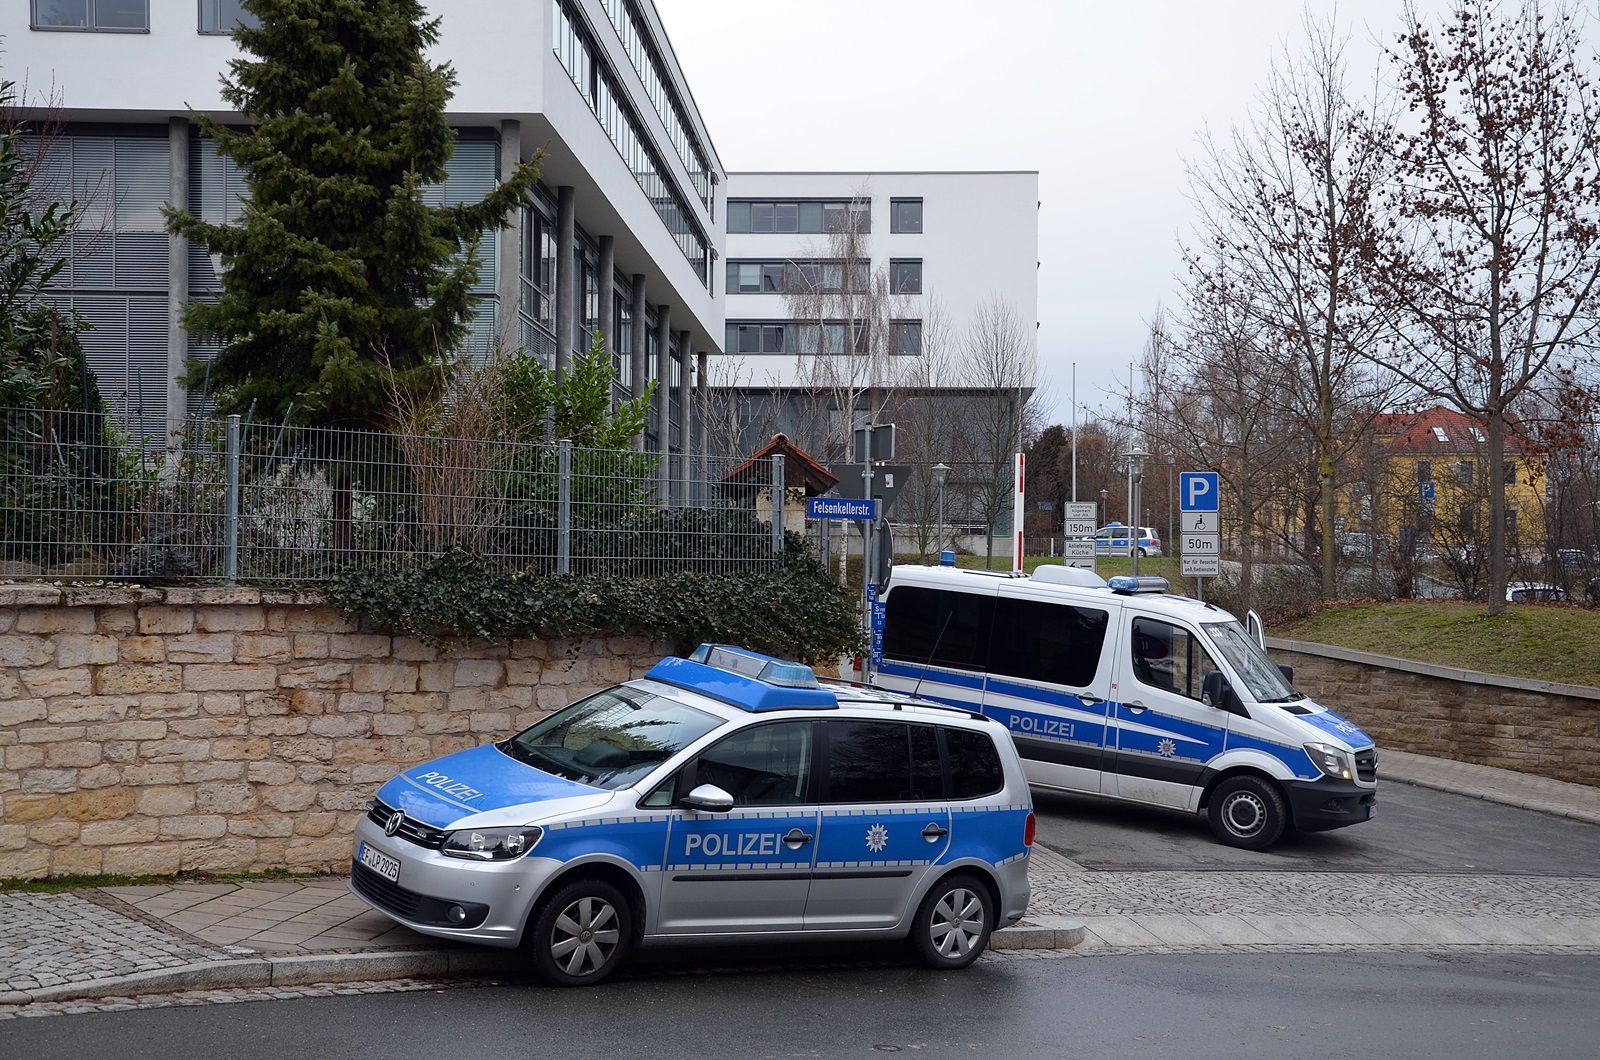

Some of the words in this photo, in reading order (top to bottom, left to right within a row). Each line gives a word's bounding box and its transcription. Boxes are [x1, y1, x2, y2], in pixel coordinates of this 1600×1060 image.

[1189, 477, 1210, 506] P
[813, 501, 870, 515] Felsenkellerstr.
[1009, 715, 1075, 737] POLIZEI
[415, 771, 484, 802] POLIZEI
[685, 833, 781, 856] POLIZEI
[362, 846, 370, 862] EF
[372, 852, 381, 868] LP
[380, 857, 398, 878] 2925
